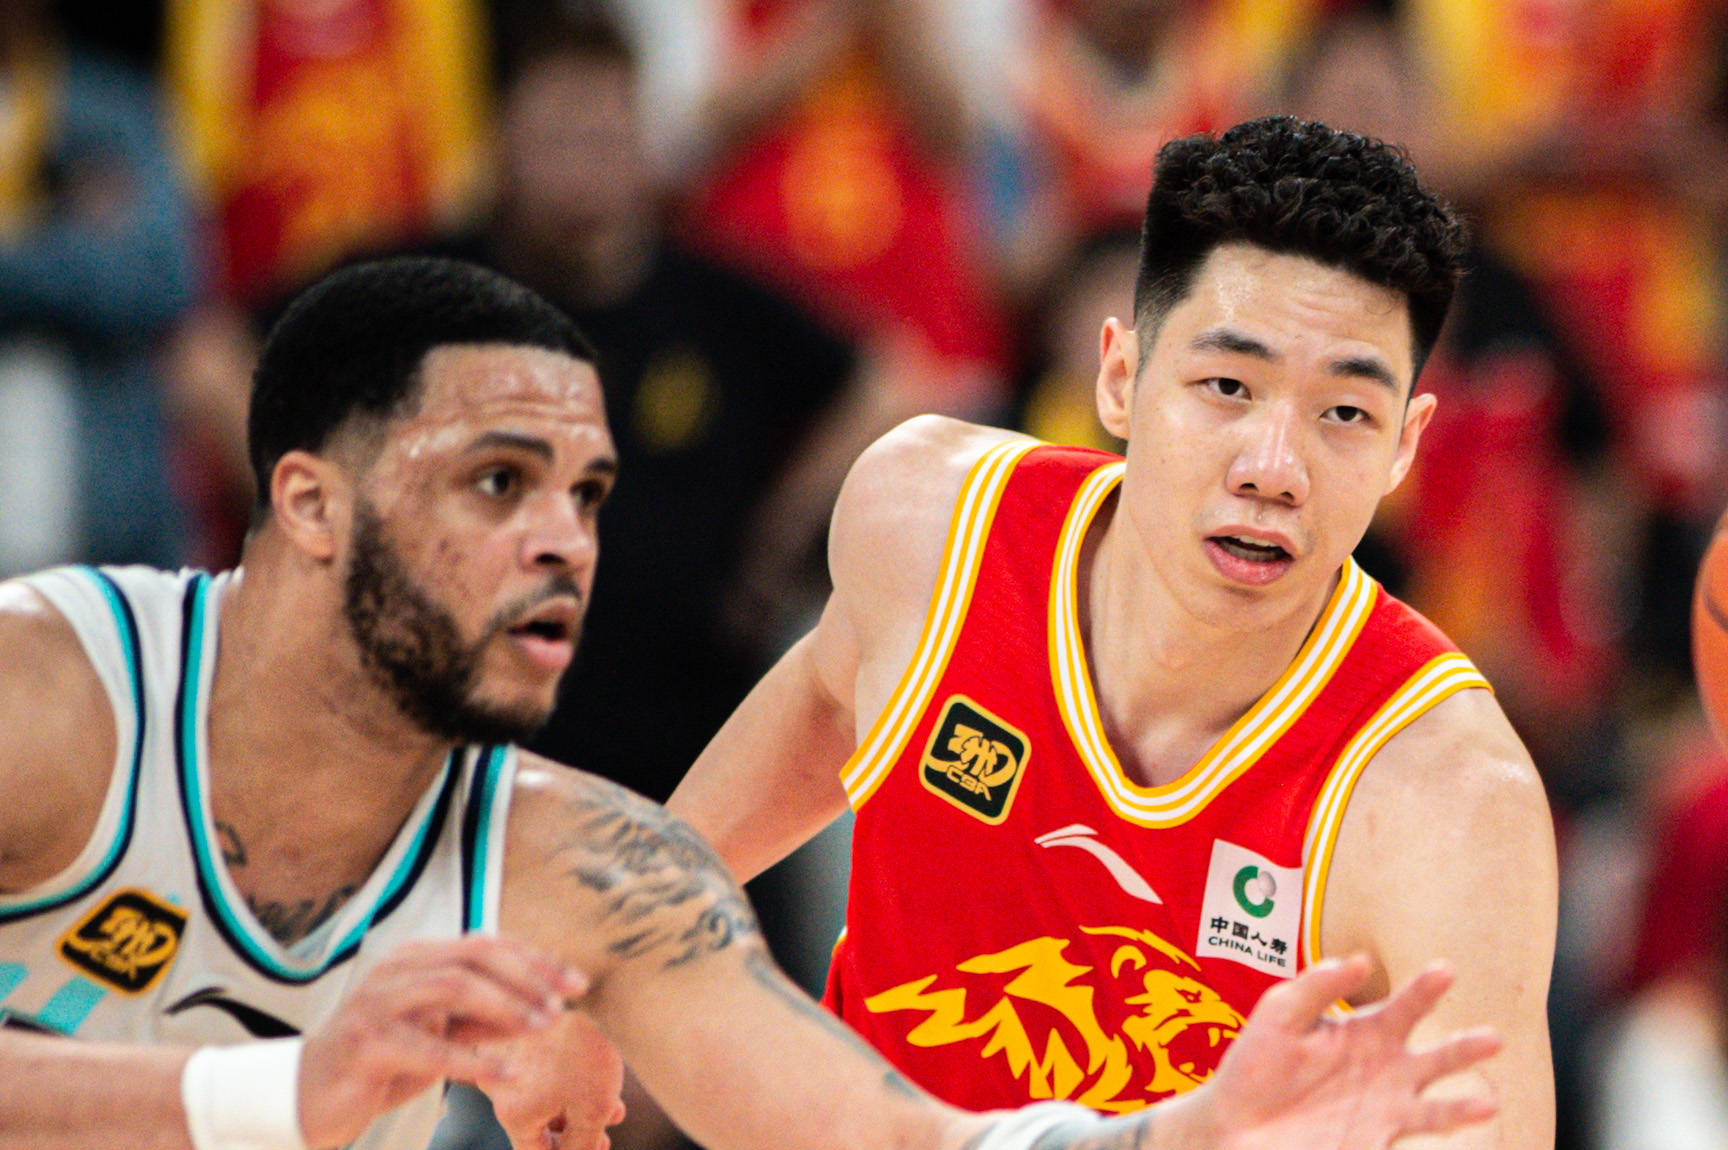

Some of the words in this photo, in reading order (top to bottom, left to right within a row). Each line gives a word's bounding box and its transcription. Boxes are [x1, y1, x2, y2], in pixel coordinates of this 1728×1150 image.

[1207, 936, 1253, 956] CHINA
[1257, 950, 1287, 968] LIFE
[1210, 916, 1288, 955] 中国人寿
